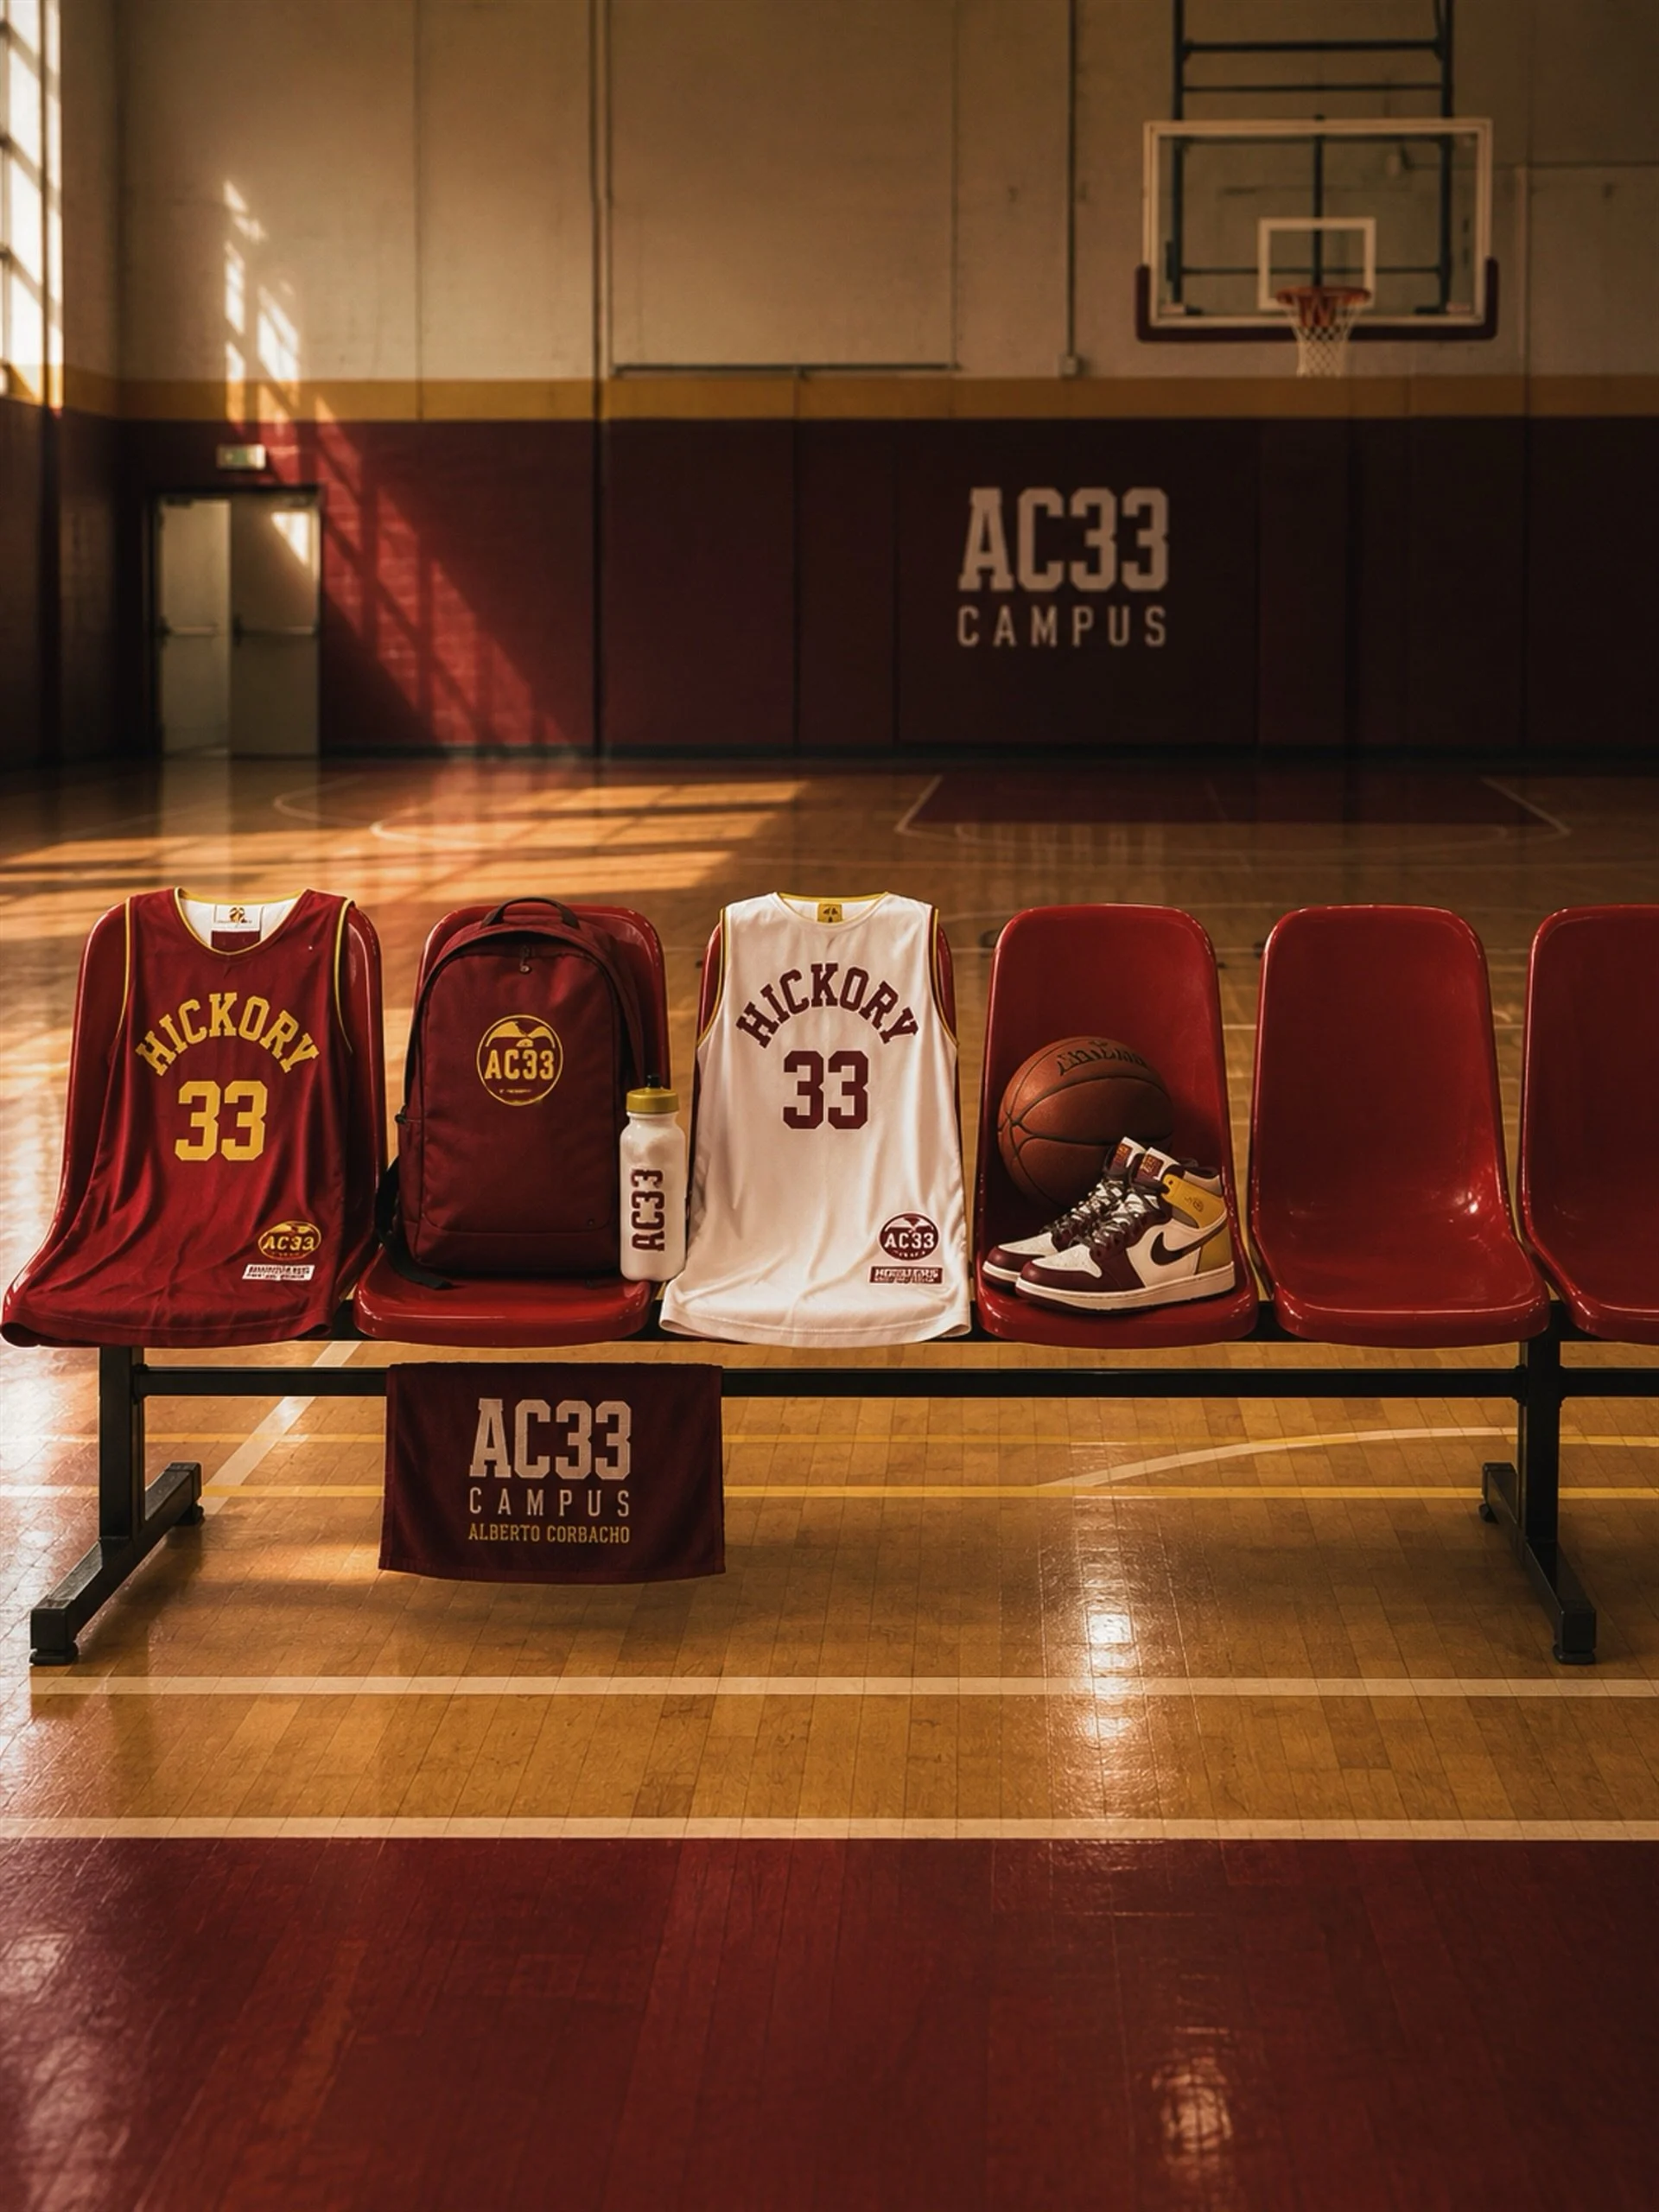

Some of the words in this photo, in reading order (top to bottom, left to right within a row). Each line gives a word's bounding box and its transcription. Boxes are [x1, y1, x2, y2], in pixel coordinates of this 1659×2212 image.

[957, 486, 1169, 592] AC33
[957, 605, 1166, 646] CAMPUS
[135, 992, 320, 1077] HICKORY
[737, 963, 919, 1049] HICKORY
[484, 1049, 555, 1080] AC33
[783, 1050, 869, 1129] 33
[175, 1080, 268, 1161] 33
[262, 1236, 315, 1251] AC33
[631, 1168, 665, 1252] AC33
[884, 1232, 934, 1249] AC33
[469, 1398, 632, 1480] AC33
[467, 1523, 541, 1542] ALBERTO
[546, 1524, 631, 1544] CORBACHO
[469, 1486, 631, 1517] CAMPUS
